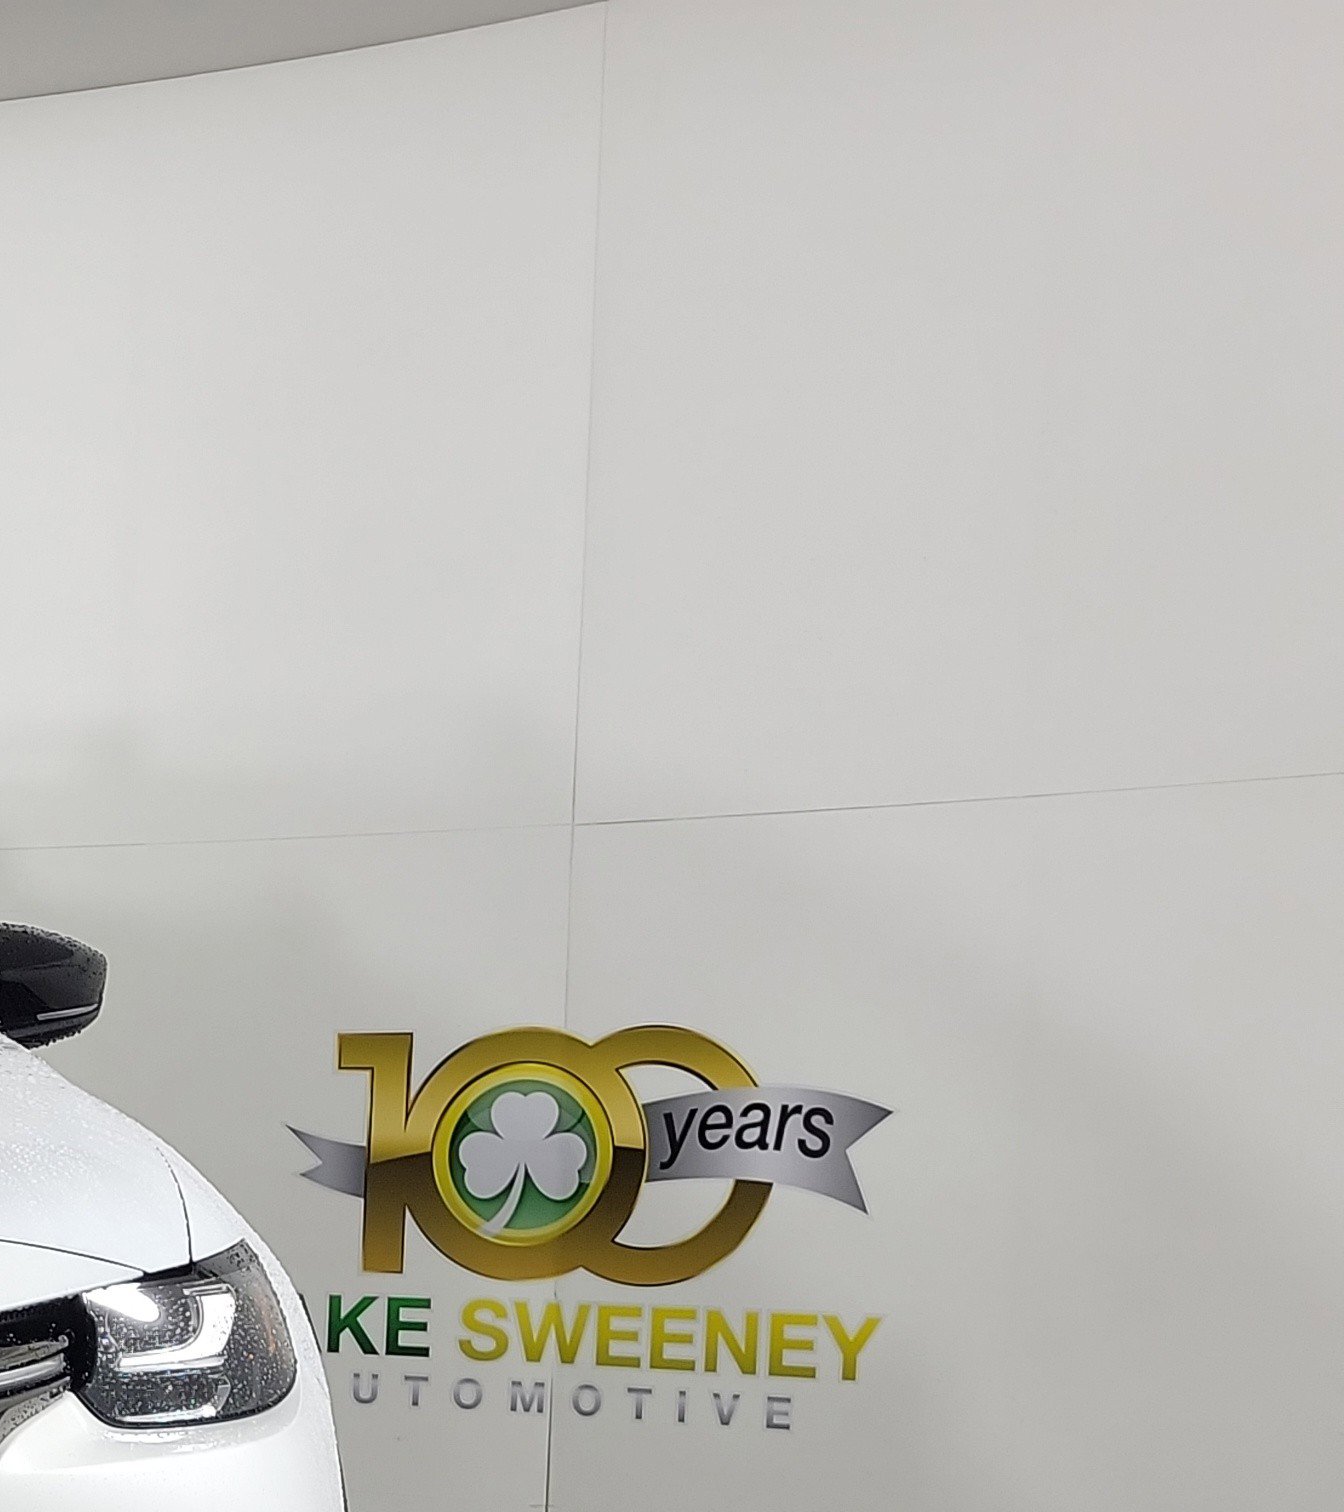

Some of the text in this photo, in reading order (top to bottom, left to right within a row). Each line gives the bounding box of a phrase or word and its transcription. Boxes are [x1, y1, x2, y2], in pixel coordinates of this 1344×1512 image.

[336, 1024, 834, 1287] 100 years
[300, 1293, 881, 1382] KE SWEENEY
[352, 1372, 792, 1431] UTOMOTIVE
